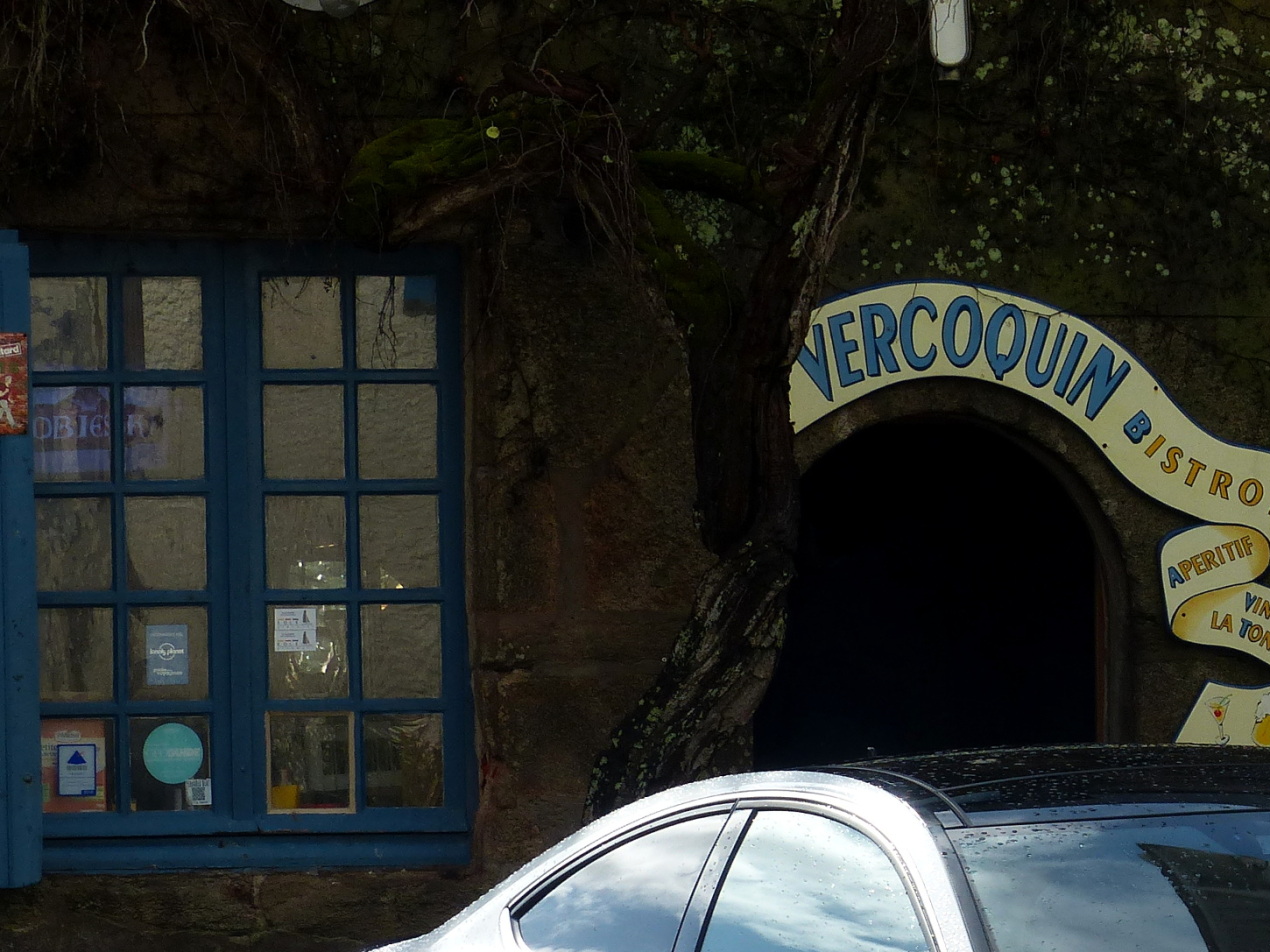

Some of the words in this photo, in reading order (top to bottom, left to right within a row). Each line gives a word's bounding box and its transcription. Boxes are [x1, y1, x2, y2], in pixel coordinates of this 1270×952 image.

[797, 293, 1131, 420] VERCOQUIN
[1168, 534, 1255, 589] APERITIF
[1211, 610, 1233, 633] LA
